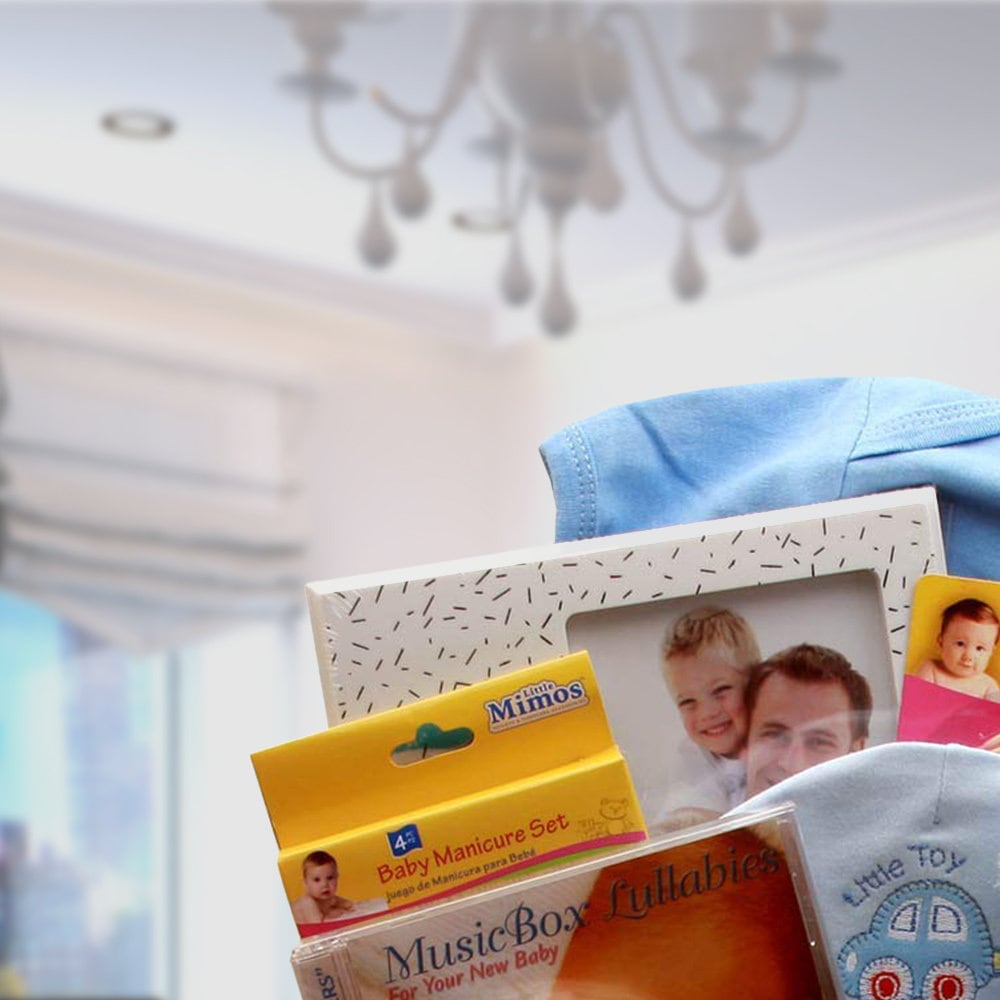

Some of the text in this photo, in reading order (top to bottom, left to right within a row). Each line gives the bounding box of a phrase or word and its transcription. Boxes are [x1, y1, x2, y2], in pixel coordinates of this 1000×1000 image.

[488, 683, 582, 723] Mimos
[523, 683, 554, 697] Little
[377, 857, 430, 885] Baby
[432, 828, 527, 868] Manicure
[529, 813, 570, 838] Set
[394, 834, 408, 850] 4
[417, 880, 432, 893] de
[432, 866, 481, 886] Manicura
[483, 857, 508, 874] para
[842, 858, 906, 908] Little
[383, 845, 781, 985] MusicBox Lullabies
[422, 972, 465, 994] Your
[469, 960, 510, 983] New
[514, 943, 559, 970] Baby
